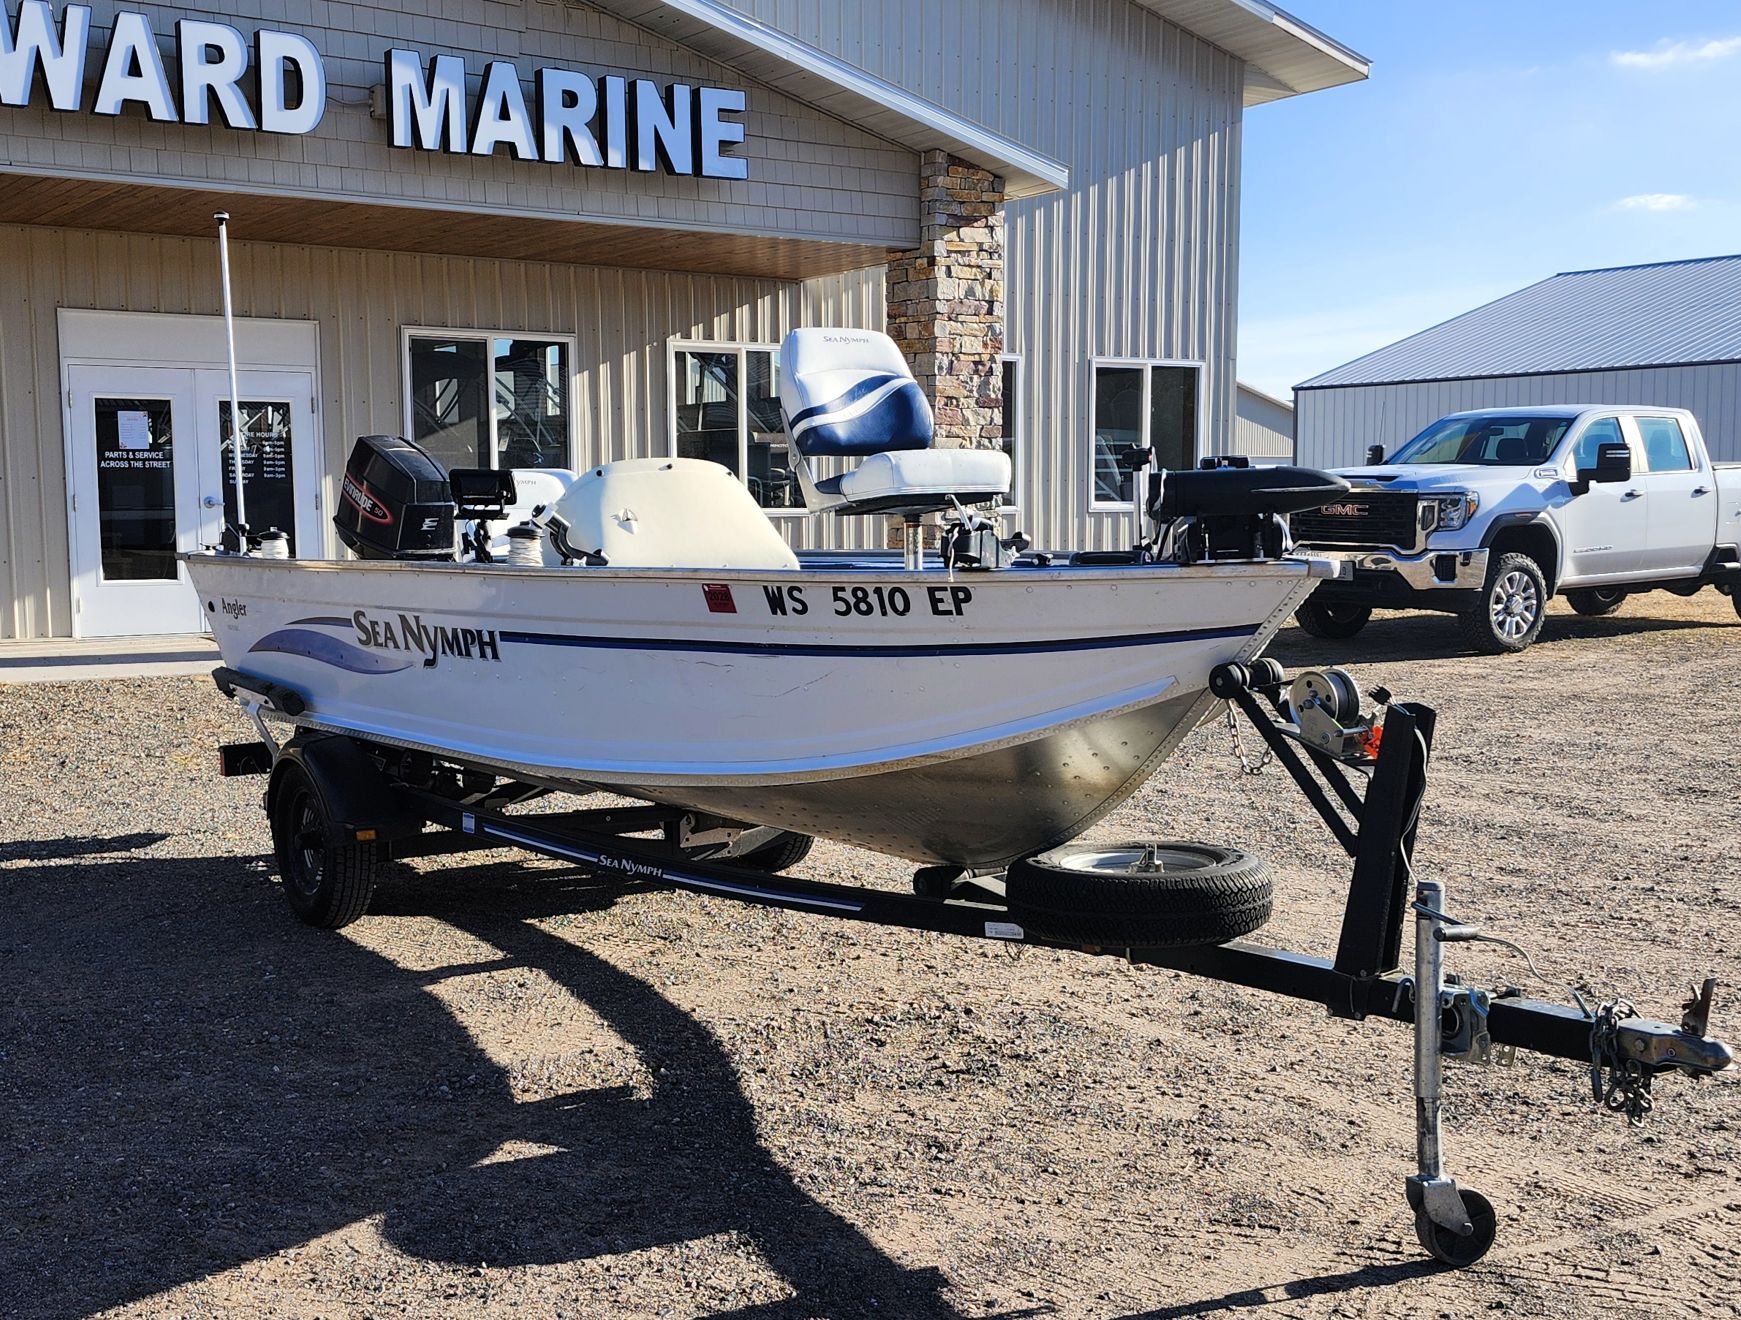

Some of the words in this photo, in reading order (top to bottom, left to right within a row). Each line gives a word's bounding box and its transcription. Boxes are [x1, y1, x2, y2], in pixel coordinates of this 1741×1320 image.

[0, 0, 327, 135] WARD
[384, 47, 749, 180] MARINE
[104, 451, 127, 459] PARTS
[128, 451, 134, 459] &
[135, 451, 164, 459] SERVICE
[100, 460, 129, 468] ACROSS
[130, 460, 144, 468] THE
[145, 460, 171, 468] STREET
[343, 477, 374, 511] EVINRUDE
[373, 507, 384, 516] 50
[1320, 504, 1369, 516] GMC
[221, 597, 247, 620] Angler
[762, 585, 809, 616] WS
[831, 586, 911, 617] 5810
[926, 586, 973, 616] EP
